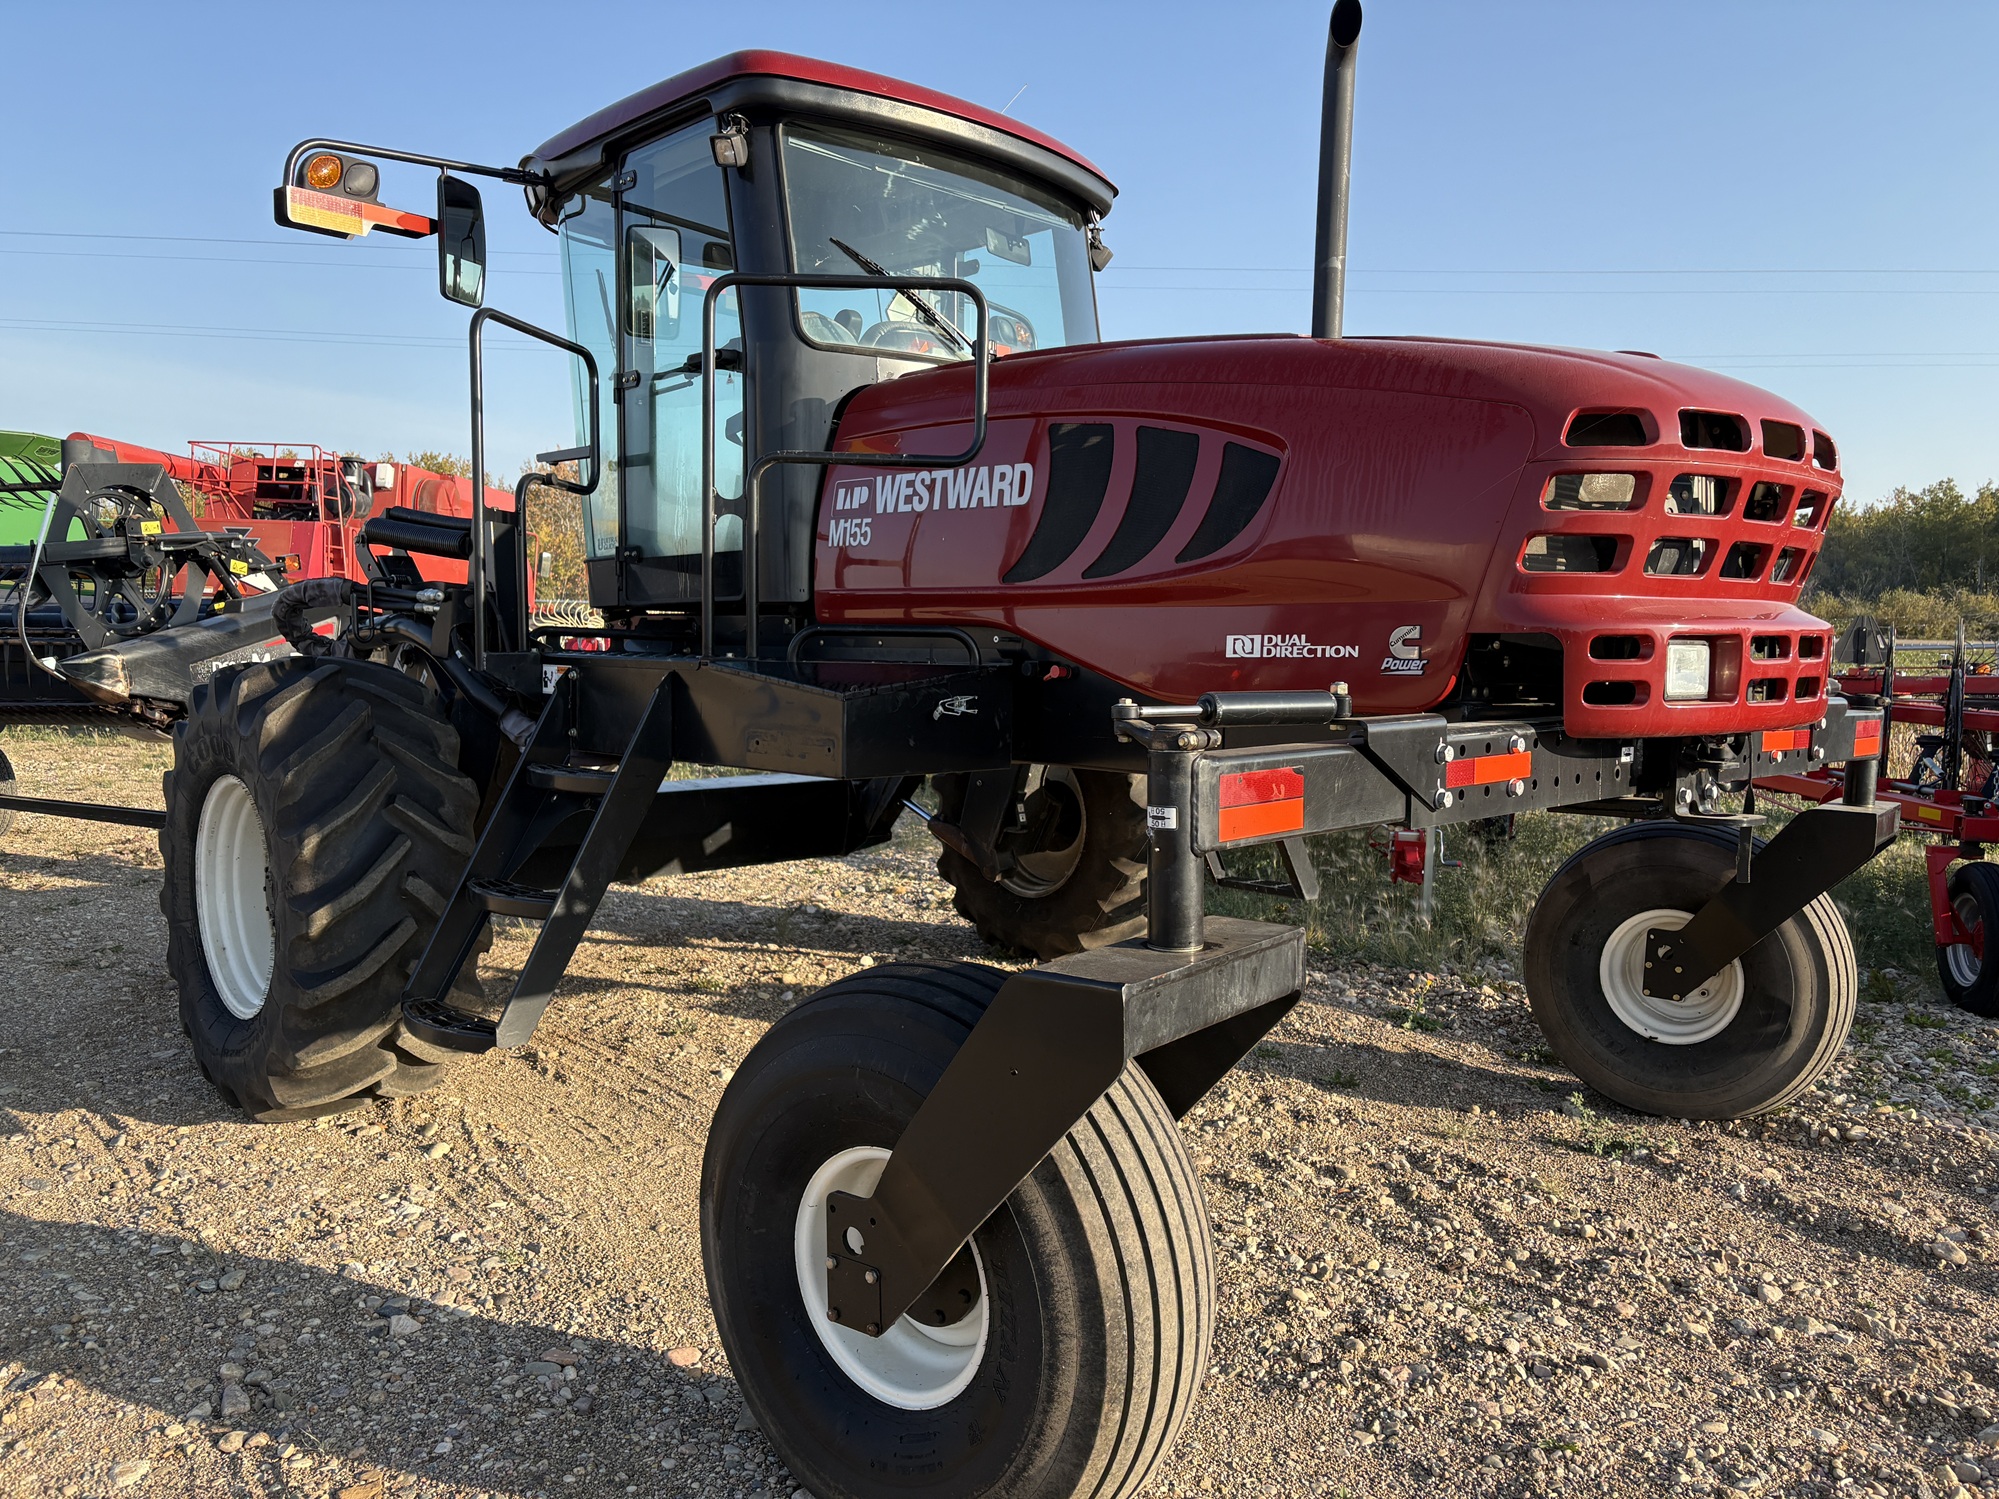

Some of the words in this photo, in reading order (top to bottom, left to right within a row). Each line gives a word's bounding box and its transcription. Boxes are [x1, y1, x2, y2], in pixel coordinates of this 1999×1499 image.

[875, 462, 1034, 514] WESTWARD
[828, 518, 872, 547] M155
[1263, 634, 1311, 646] DUAL
[1389, 625, 1418, 648] Cummins
[1263, 645, 1359, 658] DIRECTION
[1381, 657, 1428, 670] Power
